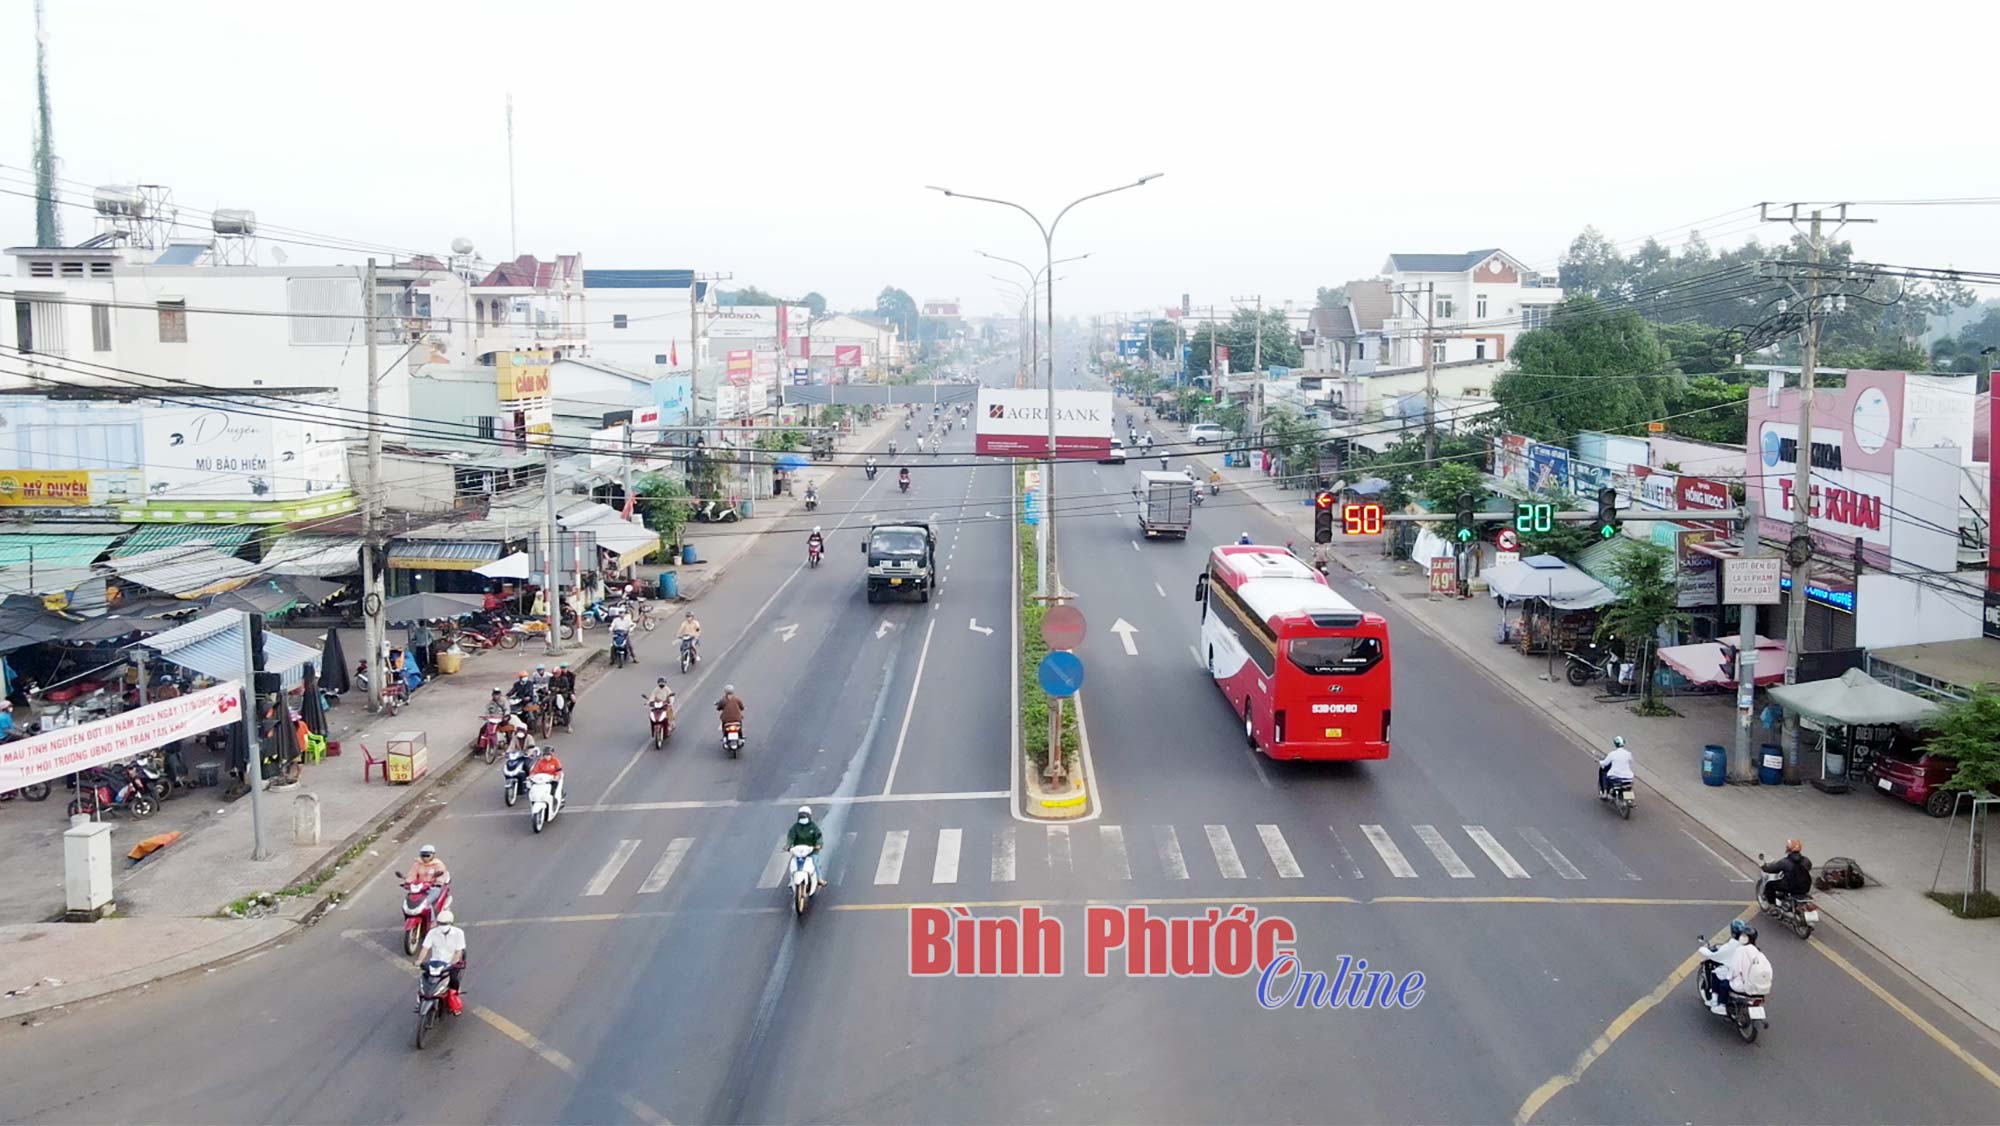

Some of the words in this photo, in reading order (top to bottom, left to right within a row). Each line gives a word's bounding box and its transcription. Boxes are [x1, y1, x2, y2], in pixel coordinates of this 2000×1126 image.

[1344, 504, 1381, 534] 50
[1517, 503, 1549, 532] 20
[1825, 487, 1881, 531] KHAI
